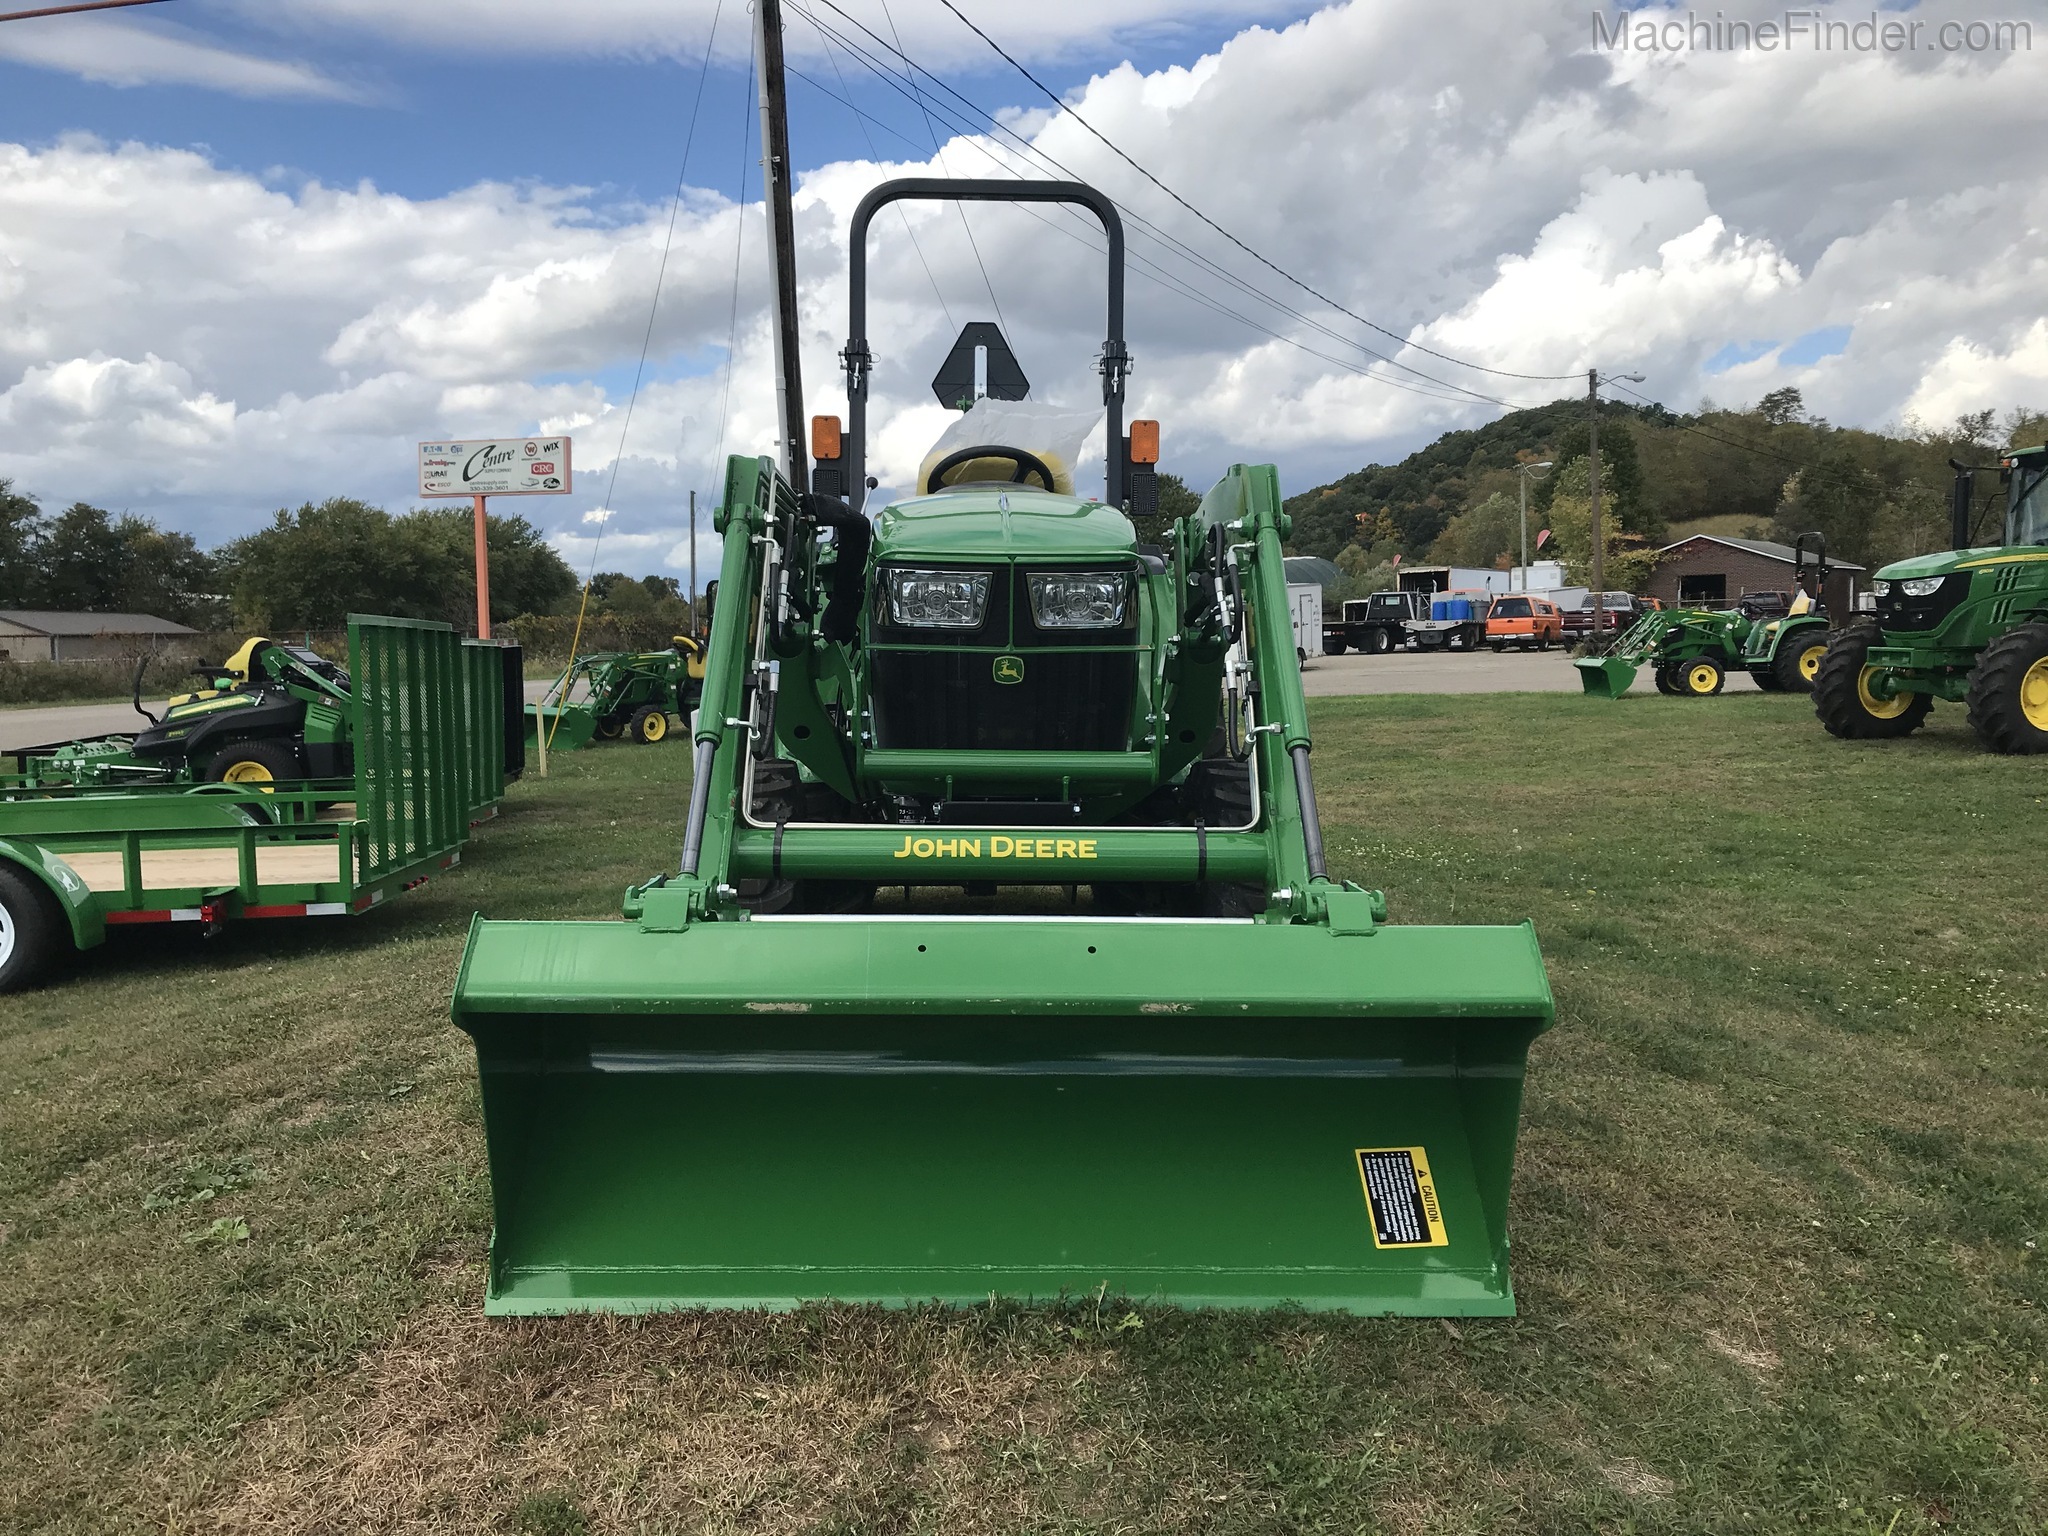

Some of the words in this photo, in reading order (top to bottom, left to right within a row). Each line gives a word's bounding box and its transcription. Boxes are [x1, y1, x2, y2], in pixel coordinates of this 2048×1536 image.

[543, 441, 560, 453] WIX
[462, 444, 515, 482] Centre
[532, 463, 553, 473] CRC
[894, 835, 981, 858] JOHN
[990, 836, 1098, 858] DEERE
[1421, 1185, 1439, 1223] CAUTION
